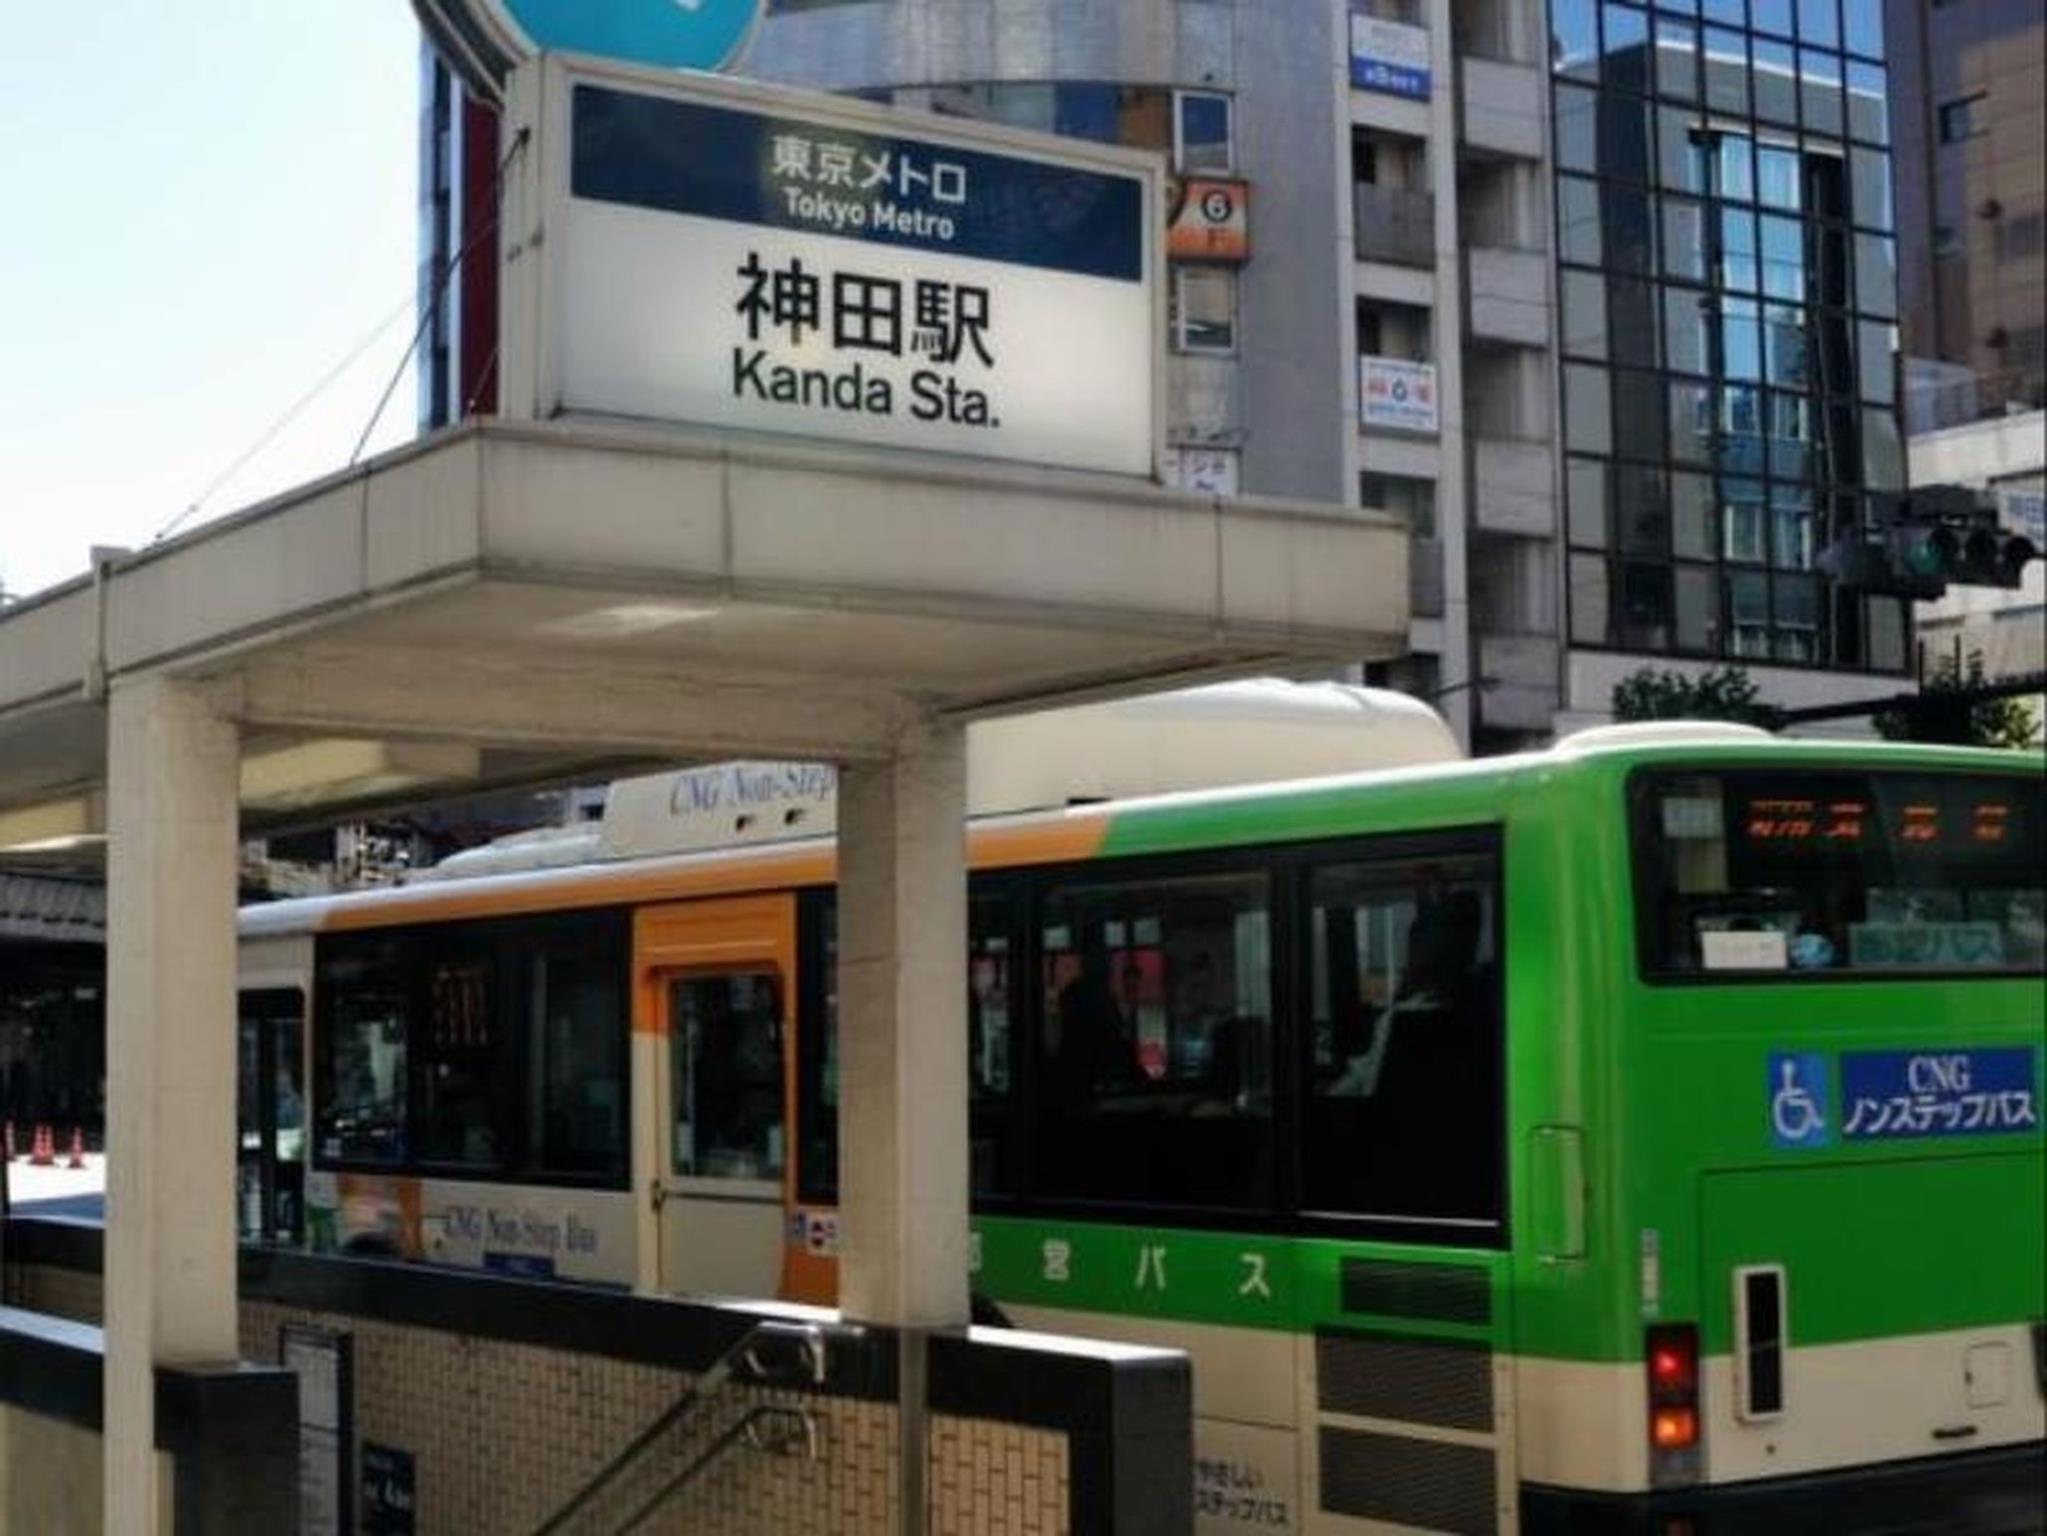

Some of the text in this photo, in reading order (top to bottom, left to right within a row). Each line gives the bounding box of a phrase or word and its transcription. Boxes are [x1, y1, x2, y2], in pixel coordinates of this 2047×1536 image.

[771, 134, 967, 205] 東京メトロ
[783, 187, 956, 240] Tokyo Metro
[736, 250, 995, 369] 神田駅
[733, 346, 1000, 428] Kanda Sta.
[1908, 1056, 1971, 1094] CNG
[1842, 1090, 2036, 1135] ノンステップバス
